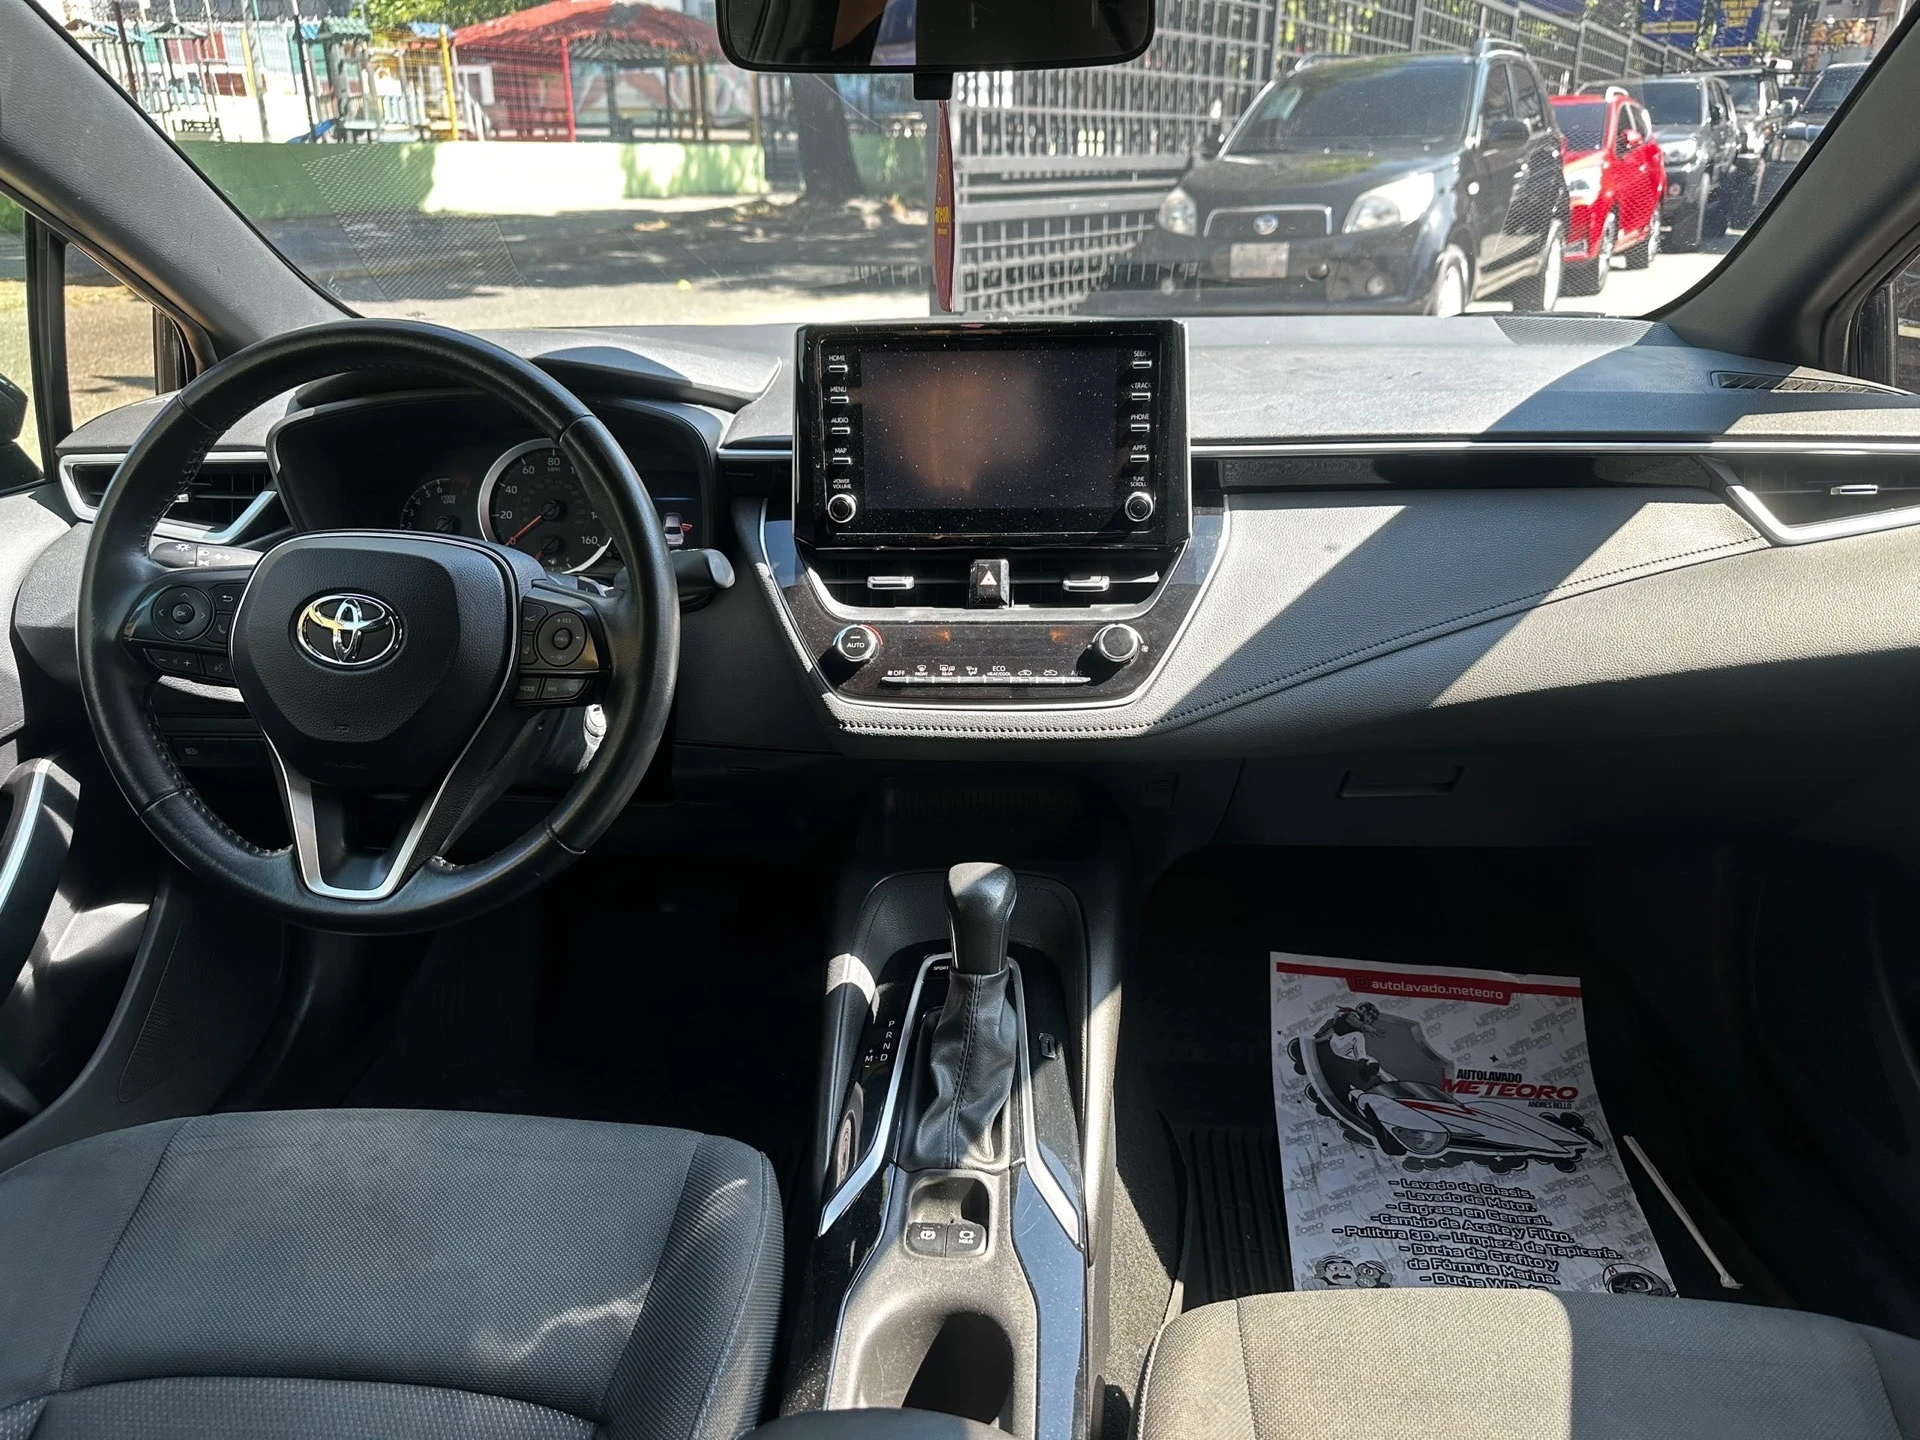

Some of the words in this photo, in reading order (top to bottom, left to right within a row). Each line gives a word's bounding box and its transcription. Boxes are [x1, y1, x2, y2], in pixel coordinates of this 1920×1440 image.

[547, 457, 561, 466] 80
[522, 466, 535, 475] 60
[425, 490, 432, 498] 5
[436, 486, 443, 494] 6
[505, 485, 518, 494] 40
[409, 508, 415, 517] 3
[500, 510, 513, 519] 20
[406, 522, 412, 530] 2
[581, 536, 598, 545] 160
[1371, 979, 1504, 1000] autolavado.meteoro
[888, 1020, 895, 1028] P
[885, 1031, 893, 1039] R
[882, 1042, 891, 1050] N
[864, 1054, 873, 1063] M
[880, 1053, 888, 1062] D
[1456, 1068, 1523, 1084] AUTOLAVADO
[1441, 1068, 1579, 1101] METEORO
[1527, 1100, 1552, 1109] ANDRES
[1552, 1101, 1573, 1110] BELLO
[1400, 1178, 1456, 1191] Lavado
[1458, 1181, 1480, 1194] de
[1480, 1183, 1536, 1200] Chasis.
[1406, 1190, 1461, 1203] Lavado
[1463, 1194, 1486, 1207] de
[1486, 1198, 1538, 1213] Motor.
[1397, 1202, 1463, 1217] Engrase
[1463, 1207, 1486, 1219] en
[1487, 1210, 1553, 1227] General.
[1440, 1217, 1463, 1231] de
[1463, 1220, 1513, 1236] Aceite
[1511, 1227, 1526, 1240] y
[1527, 1228, 1576, 1244] Filtro.
[1344, 1225, 1409, 1241] Pulitura
[1409, 1230, 1438, 1243] 3D.
[1451, 1231, 1521, 1252] Limpieza
[1522, 1240, 1546, 1254] de
[1546, 1243, 1624, 1260] Tapicería.
[1411, 1243, 1464, 1258] Ducha
[1465, 1247, 1488, 1261] de
[1488, 1250, 1547, 1268] Grafito
[1546, 1259, 1560, 1273] y
[1407, 1258, 1430, 1271] de
[1429, 1257, 1500, 1275] Fórmula
[1500, 1265, 1562, 1286] Marina.
[1432, 1273, 1488, 1289] Ducha
